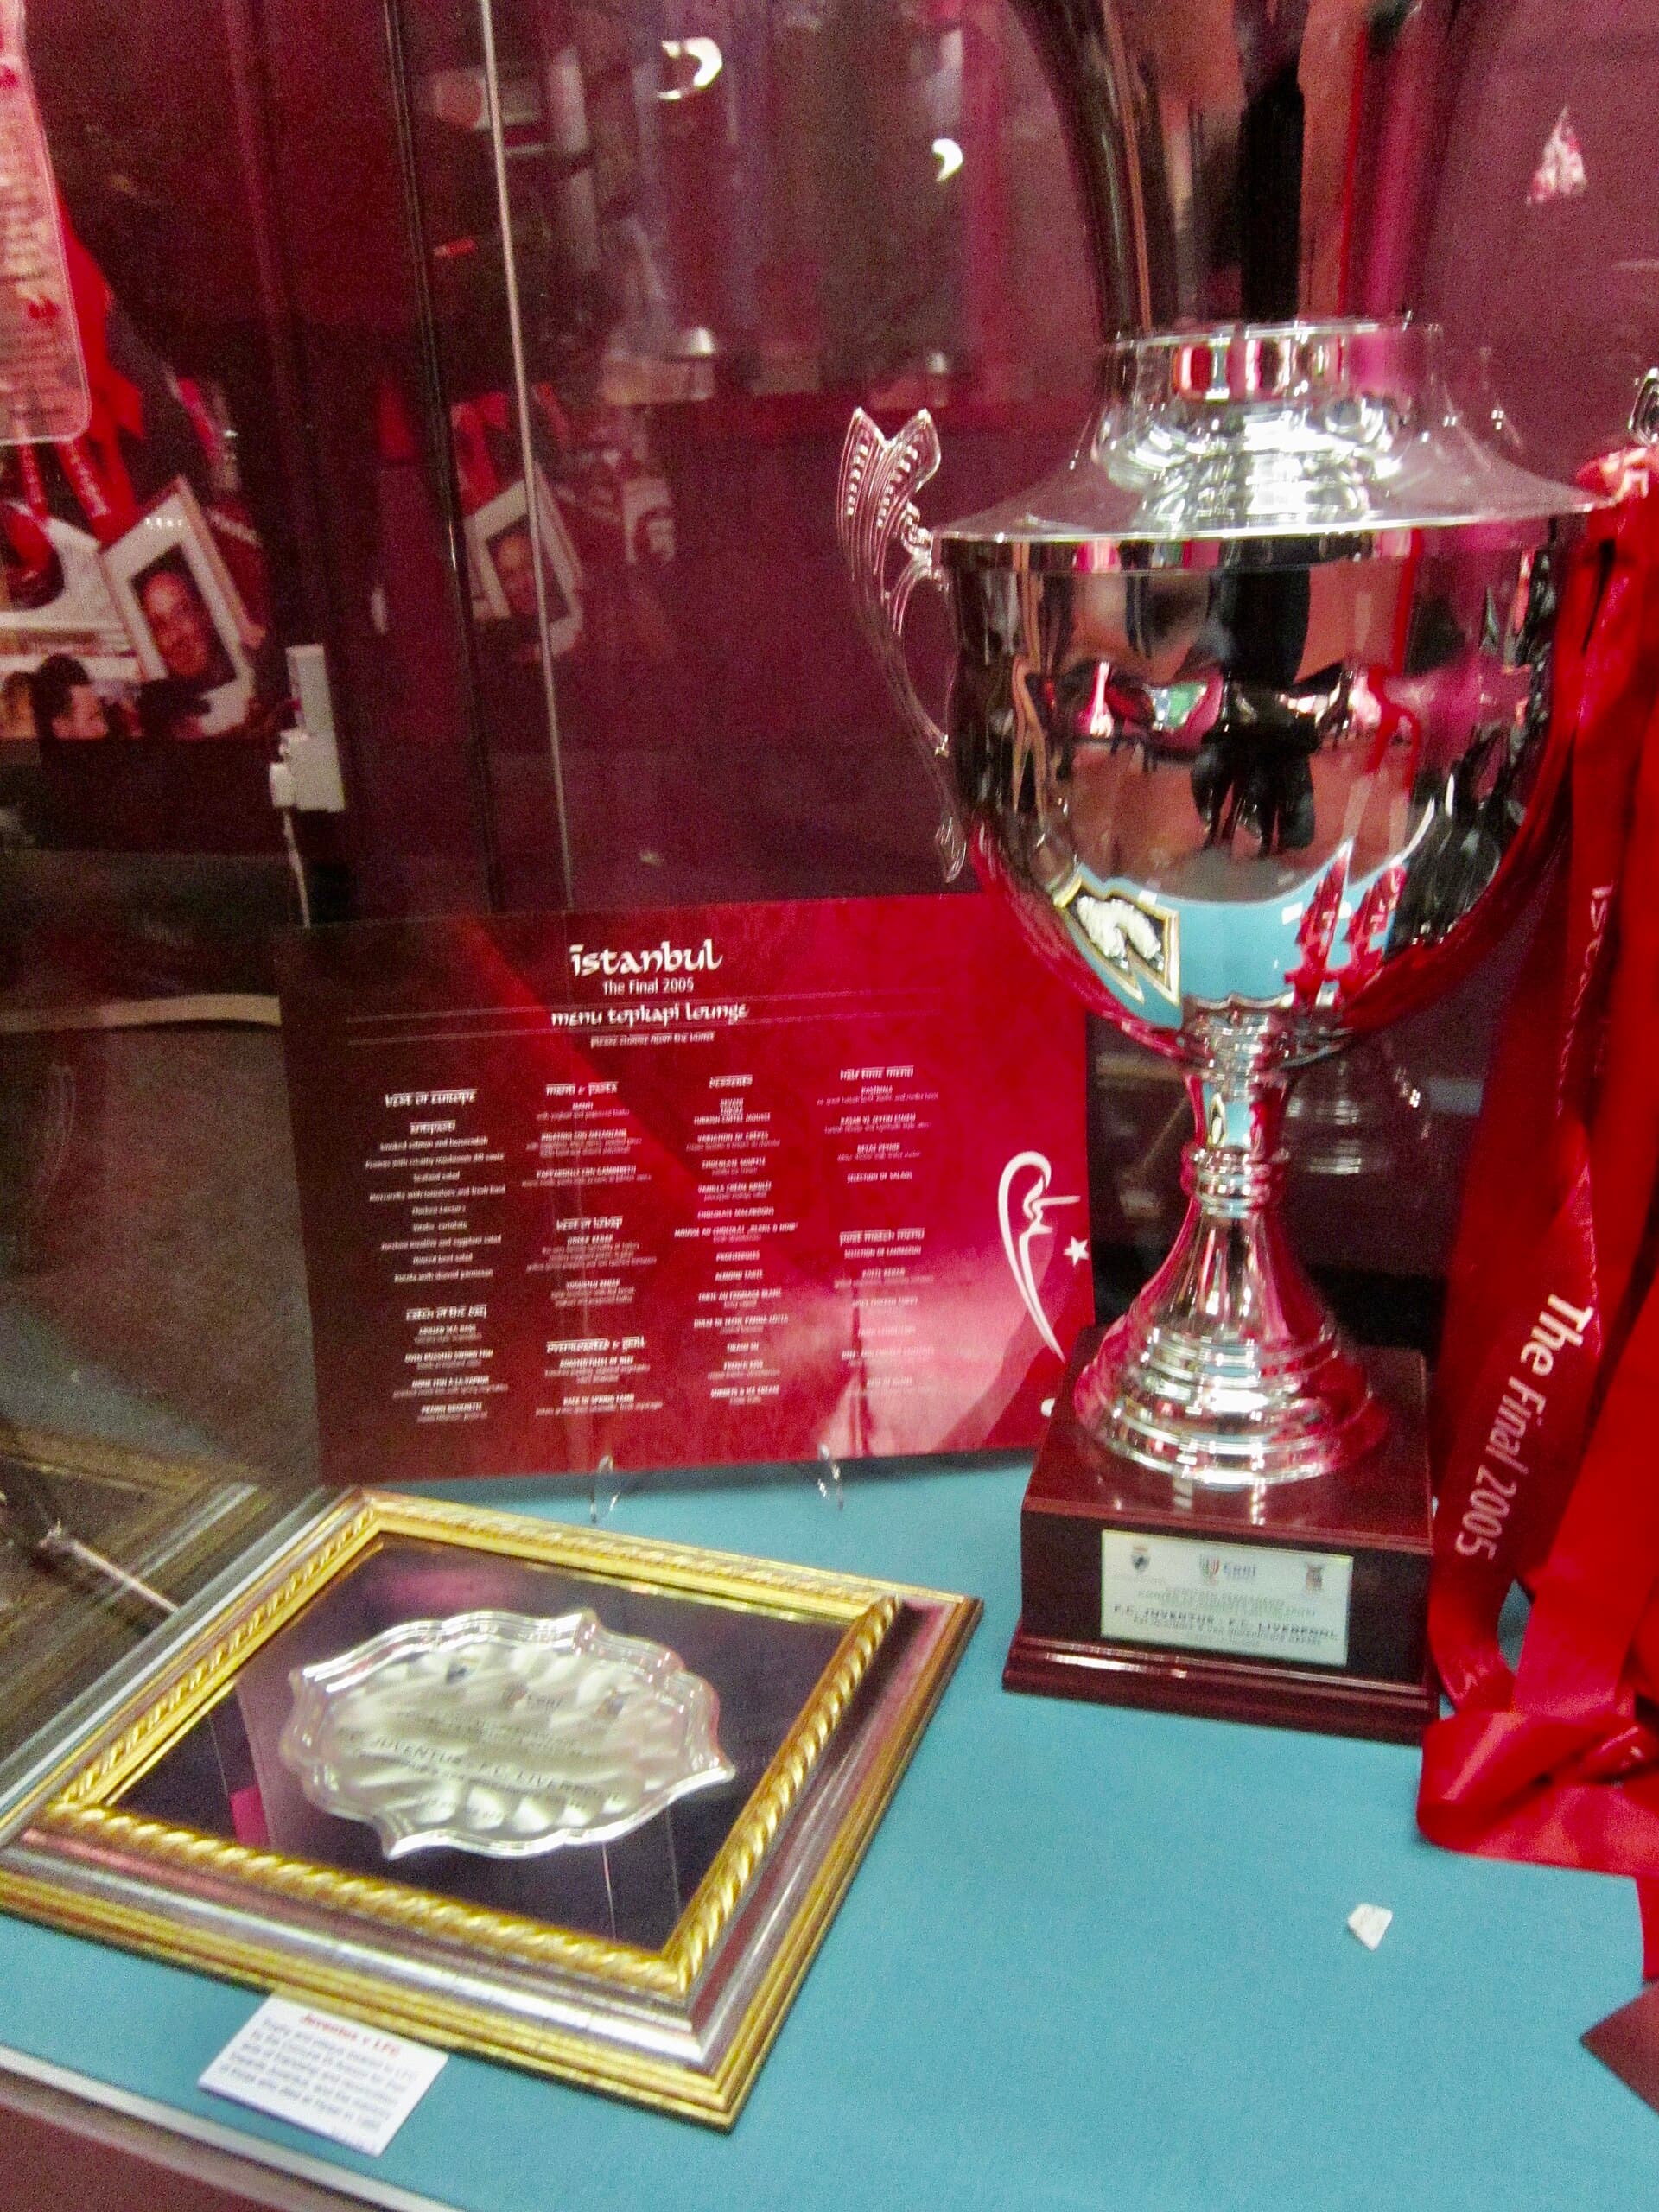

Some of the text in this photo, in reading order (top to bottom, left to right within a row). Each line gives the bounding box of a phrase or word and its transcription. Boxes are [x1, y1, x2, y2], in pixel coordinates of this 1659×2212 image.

[603, 977, 694, 995] The Final 2005
[551, 1010, 602, 1026] menu
[685, 1001, 748, 1025] lounge
[1455, 1294, 1594, 1560] The Final 2005
